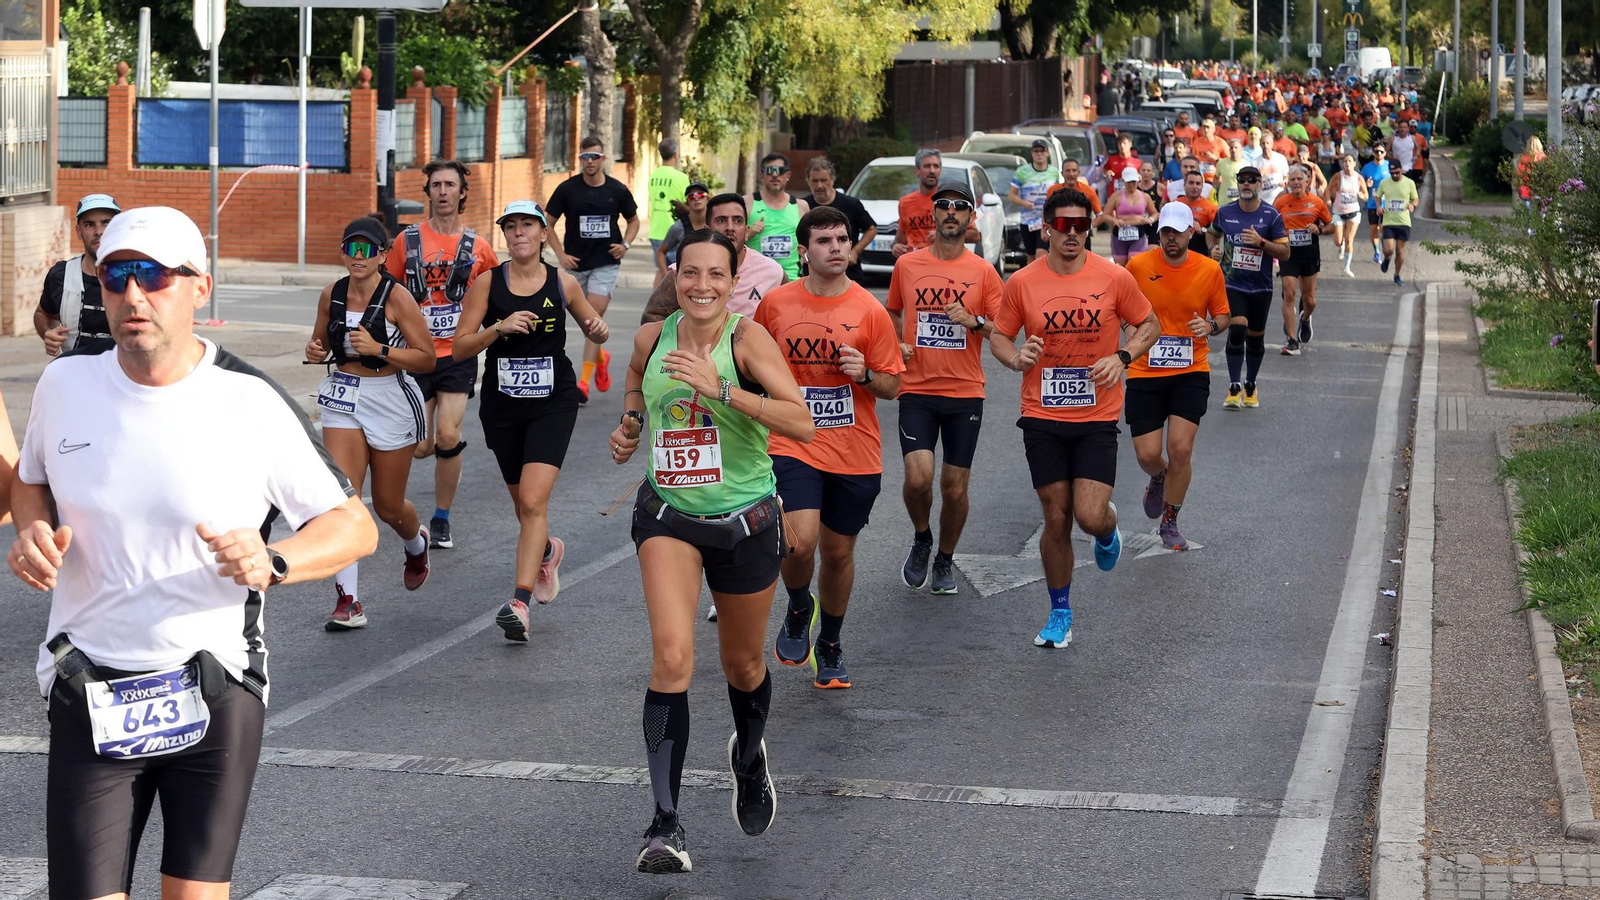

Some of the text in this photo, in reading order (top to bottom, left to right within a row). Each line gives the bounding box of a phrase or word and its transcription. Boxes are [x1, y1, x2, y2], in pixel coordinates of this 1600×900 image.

[586, 223, 605, 231] 1079
[768, 242, 786, 251] 672
[1240, 254, 1255, 264] 144
[914, 287, 966, 308] XXIX
[432, 315, 454, 328] 689
[1043, 309, 1101, 330] XXIX
[929, 324, 954, 338] 906
[785, 337, 842, 360] XXIX
[1160, 346, 1183, 358] 734
[511, 371, 540, 385] 720
[519, 387, 550, 396] MIZUNO
[1050, 381, 1087, 395] 1052
[326, 400, 353, 412] MIZUNO
[1061, 397, 1092, 405] MIZUNO
[816, 417, 851, 427] MIZUNO
[665, 448, 700, 469] 159
[673, 474, 717, 485] MIZUNO
[123, 699, 181, 734] 643
[141, 729, 202, 753] MIZUNO
